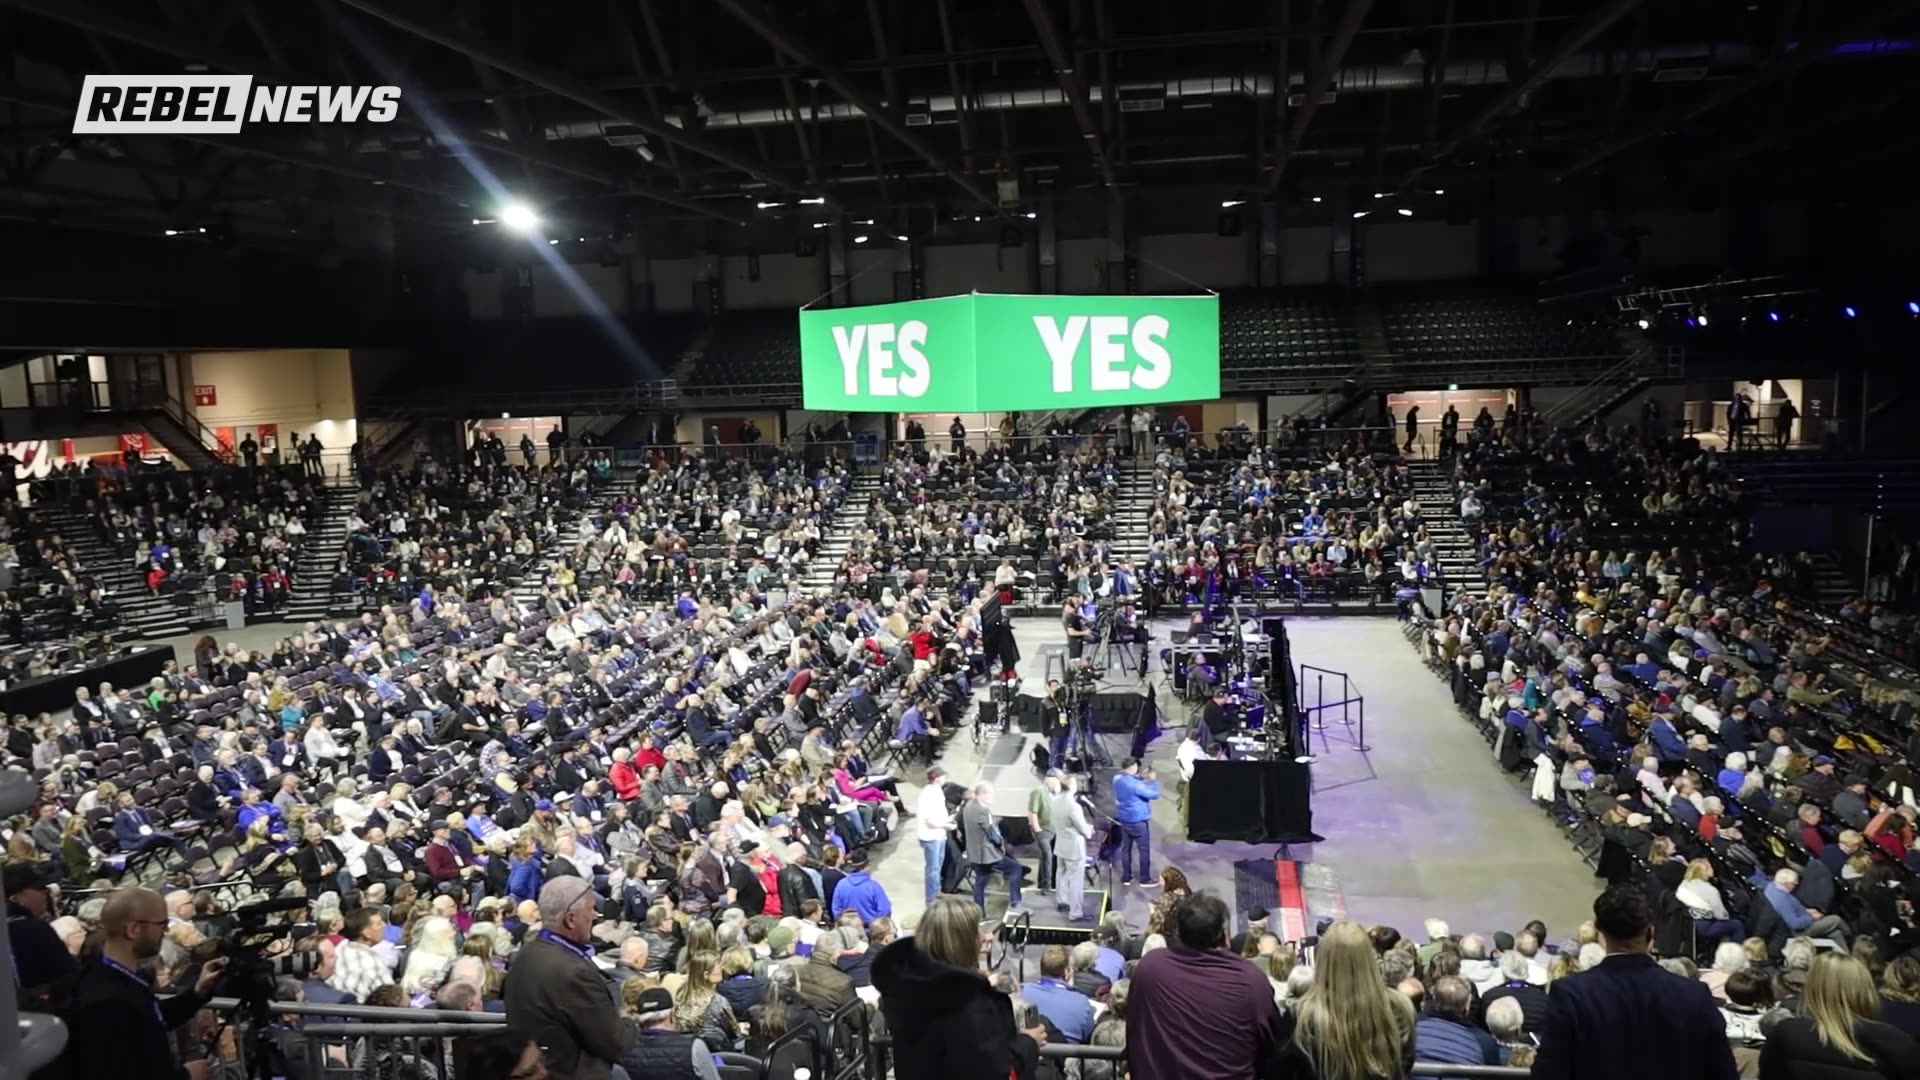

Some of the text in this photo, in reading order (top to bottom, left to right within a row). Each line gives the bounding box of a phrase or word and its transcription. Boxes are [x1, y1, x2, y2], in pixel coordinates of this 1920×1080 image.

[195, 386, 214, 396] EXIT
[832, 320, 930, 398] YES
[1033, 314, 1172, 393] YES
